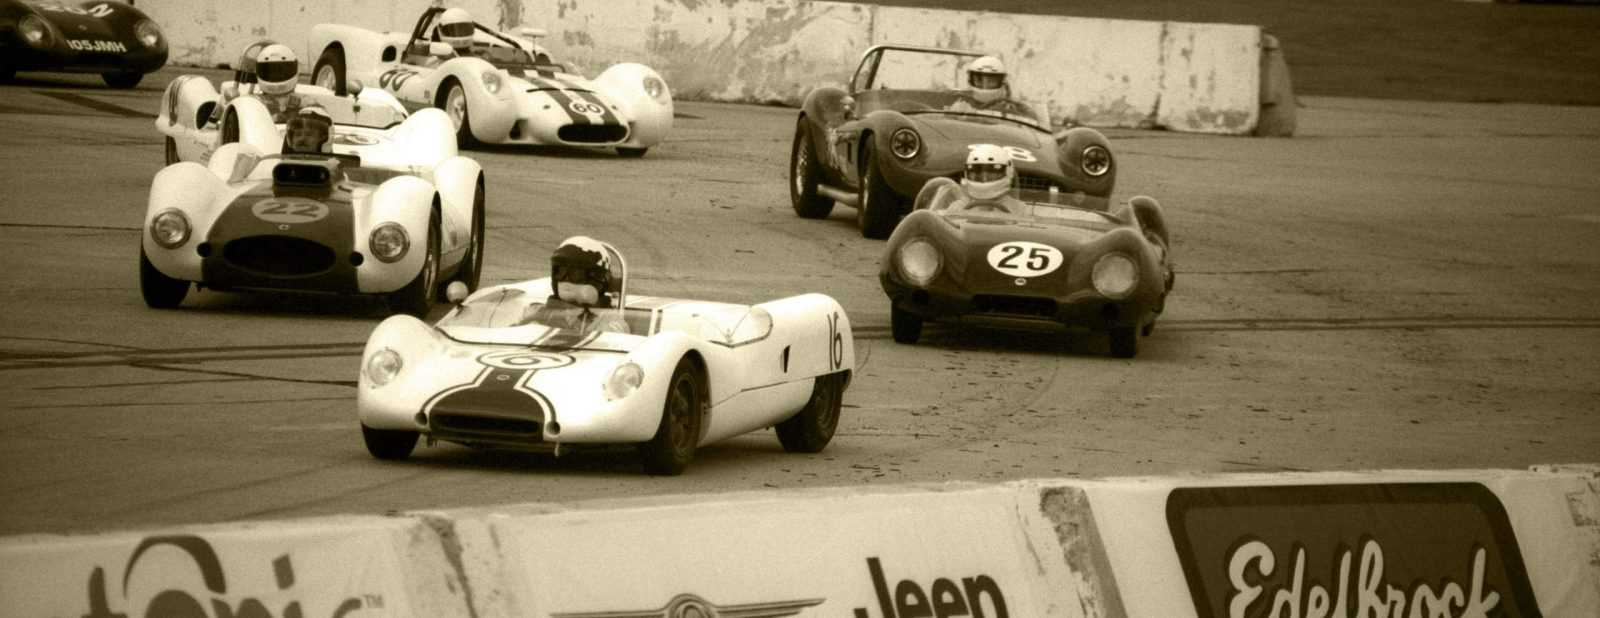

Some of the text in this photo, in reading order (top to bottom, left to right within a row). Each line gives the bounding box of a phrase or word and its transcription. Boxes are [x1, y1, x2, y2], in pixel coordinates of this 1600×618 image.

[66, 39, 128, 53] 105JMH
[572, 103, 601, 114] 60
[261, 202, 320, 218] 22
[997, 245, 1051, 271] 25
[827, 311, 843, 371] 16
[1228, 539, 1500, 618] Edelbrock
